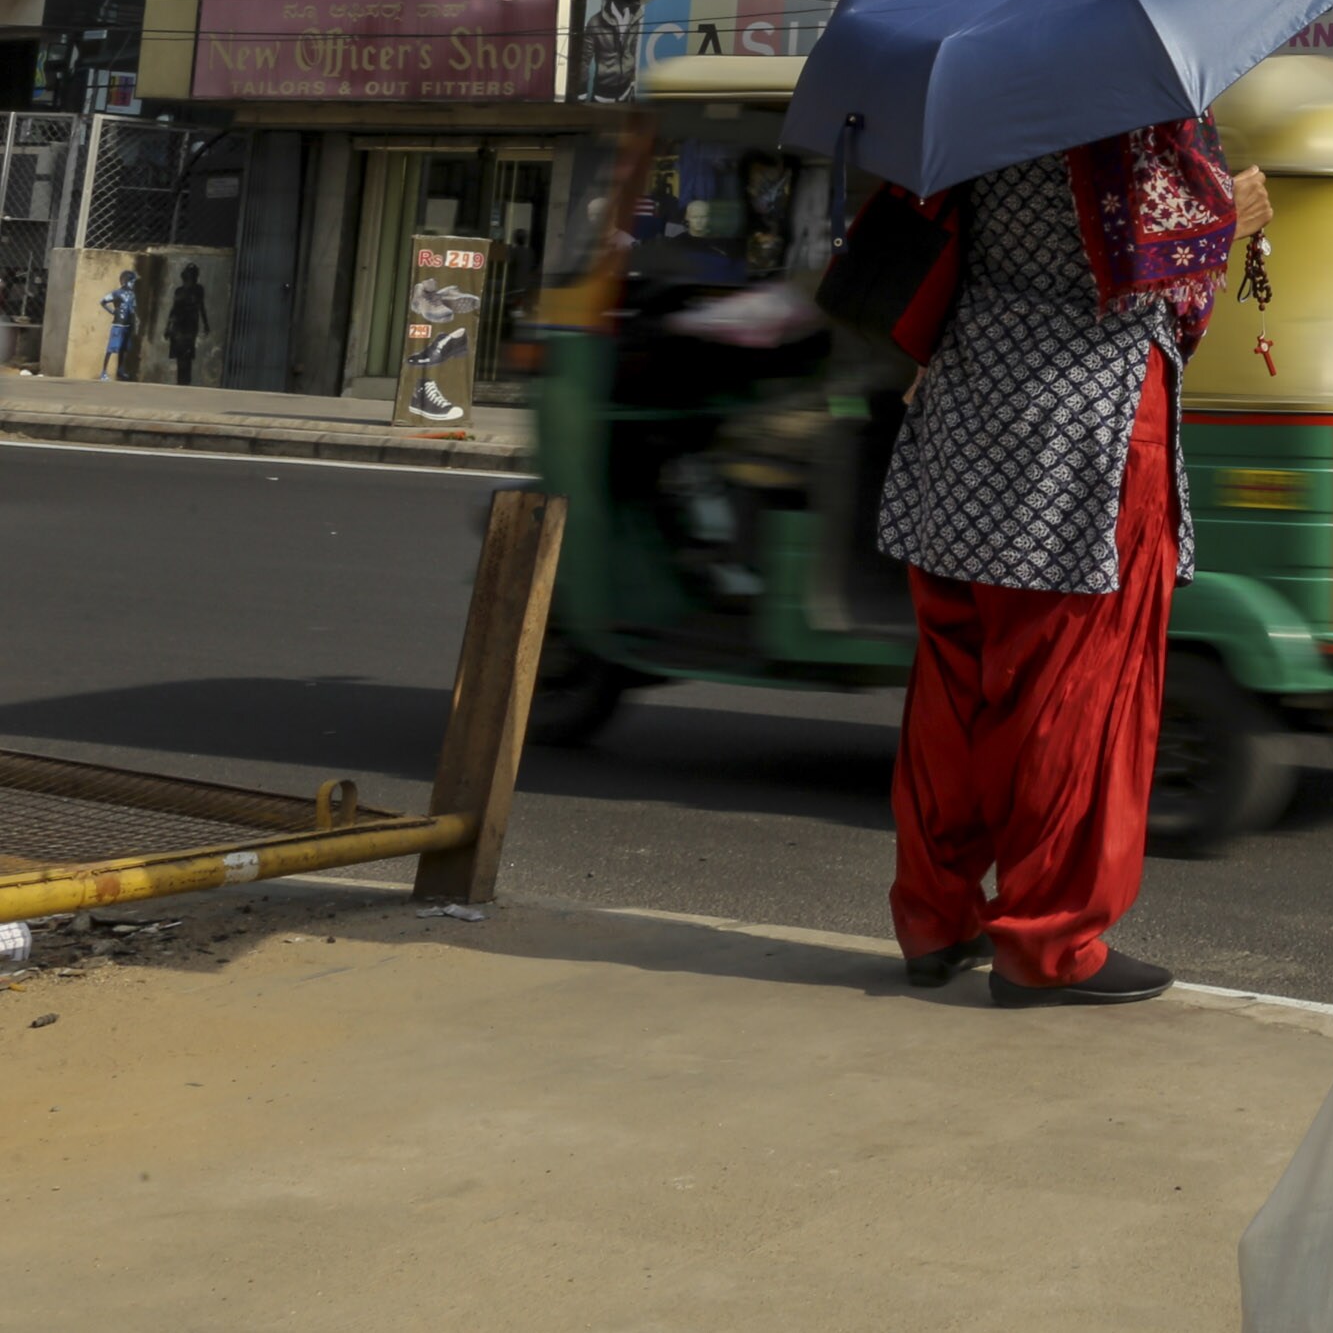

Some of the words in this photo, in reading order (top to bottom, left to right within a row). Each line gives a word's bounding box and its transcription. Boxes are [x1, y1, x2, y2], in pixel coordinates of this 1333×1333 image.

[208, 29, 281, 72] New
[295, 26, 432, 77] Officer's
[448, 25, 547, 82] Shop
[231, 80, 333, 96] TAILORS
[338, 80, 353, 96] &
[365, 81, 410, 96] OUT
[422, 81, 515, 96] FITTERS
[418, 249, 444, 267] Rs
